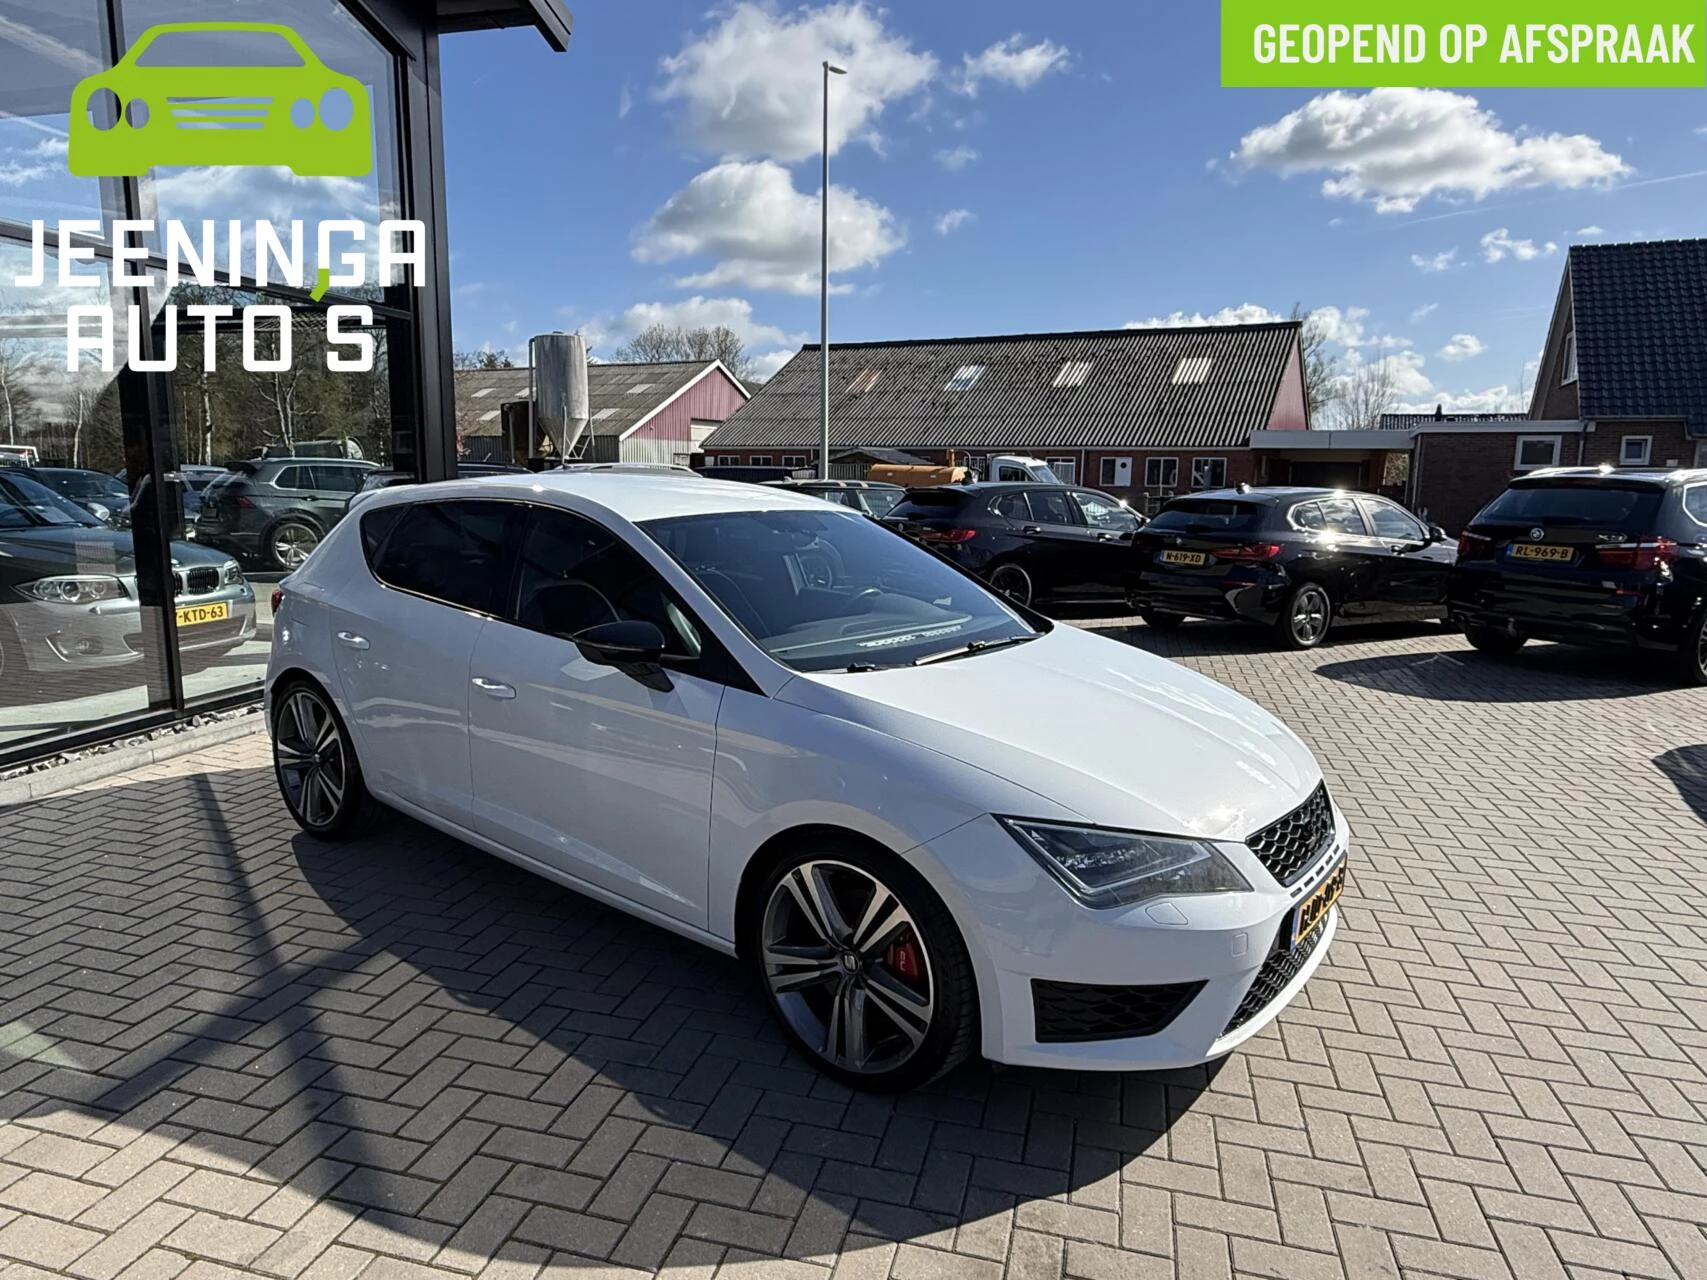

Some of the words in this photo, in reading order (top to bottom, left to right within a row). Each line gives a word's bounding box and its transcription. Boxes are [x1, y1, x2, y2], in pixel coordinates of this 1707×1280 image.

[1165, 551, 1203, 564] N-619-XD
[1514, 545, 1570, 560] RL-969-B
[175, 605, 224, 623] -KTD-63
